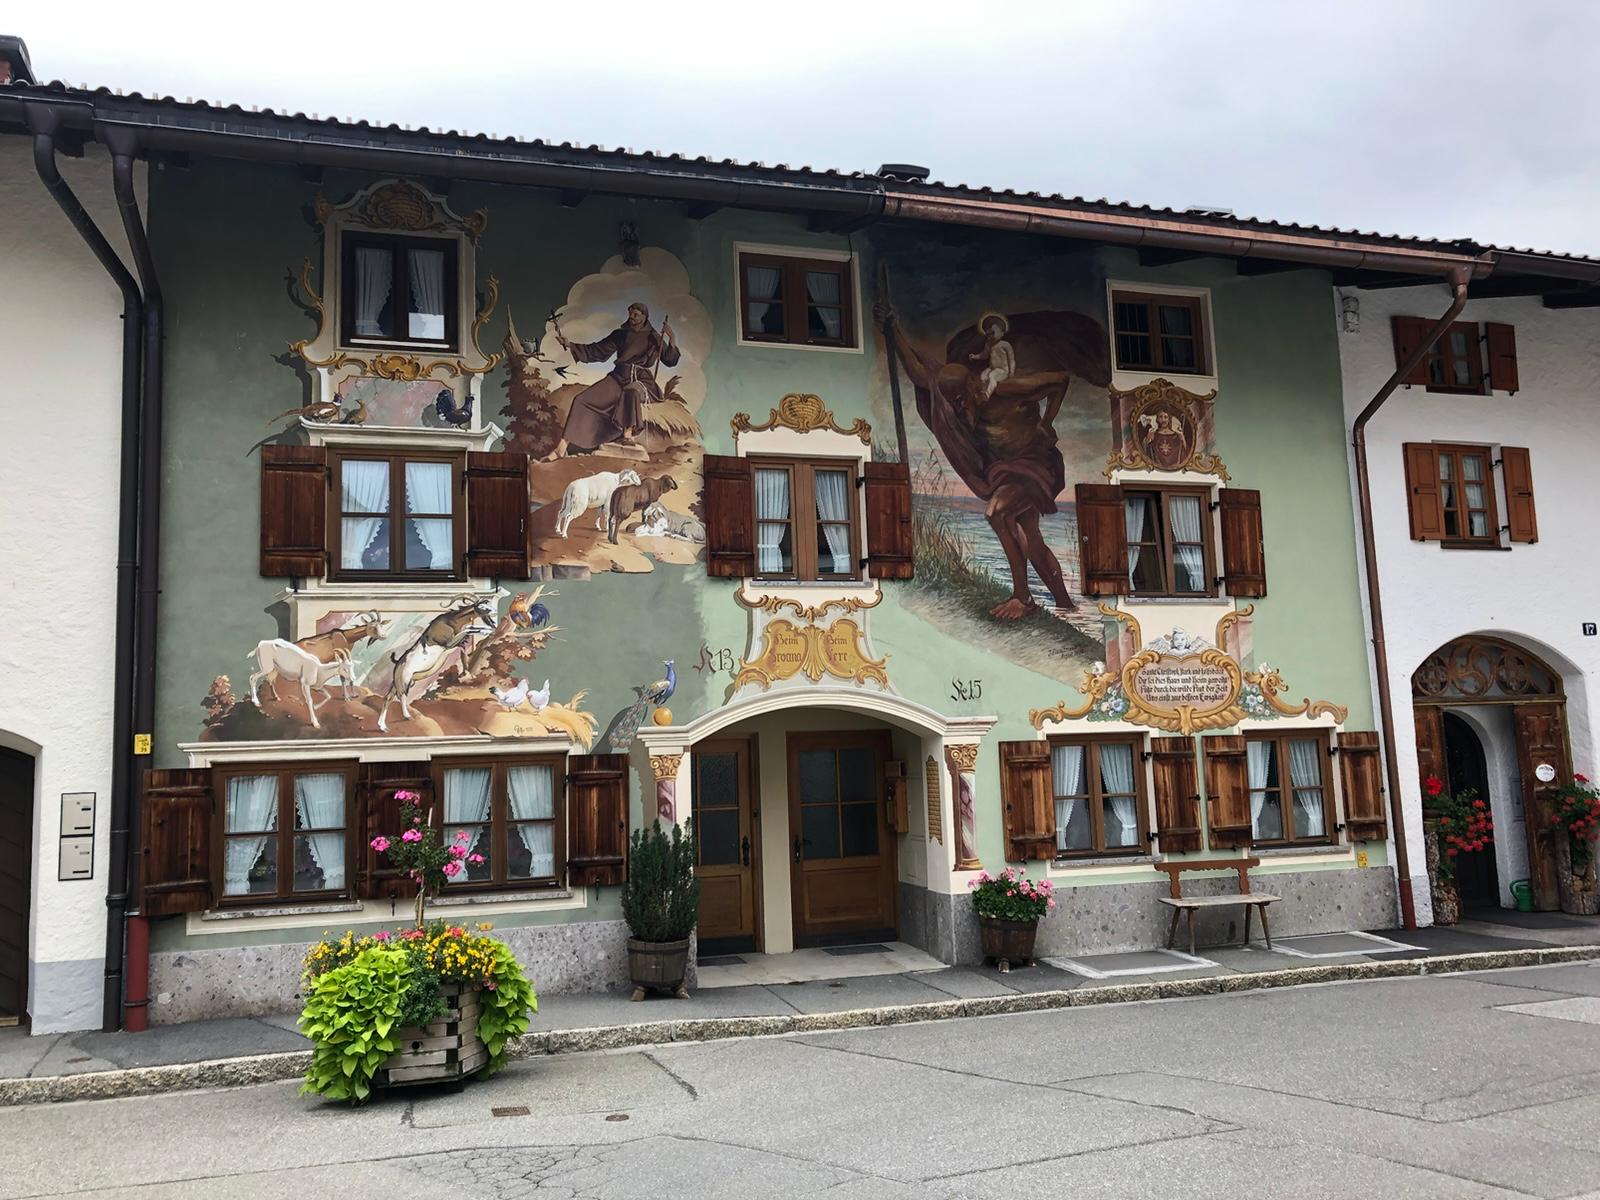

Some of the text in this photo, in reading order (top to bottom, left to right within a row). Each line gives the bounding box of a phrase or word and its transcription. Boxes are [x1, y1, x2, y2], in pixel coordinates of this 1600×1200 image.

[1585, 624, 1594, 634] 17
[774, 633, 799, 645] Beim
[826, 634, 848, 645] Beim
[1181, 676, 1191, 684] und
